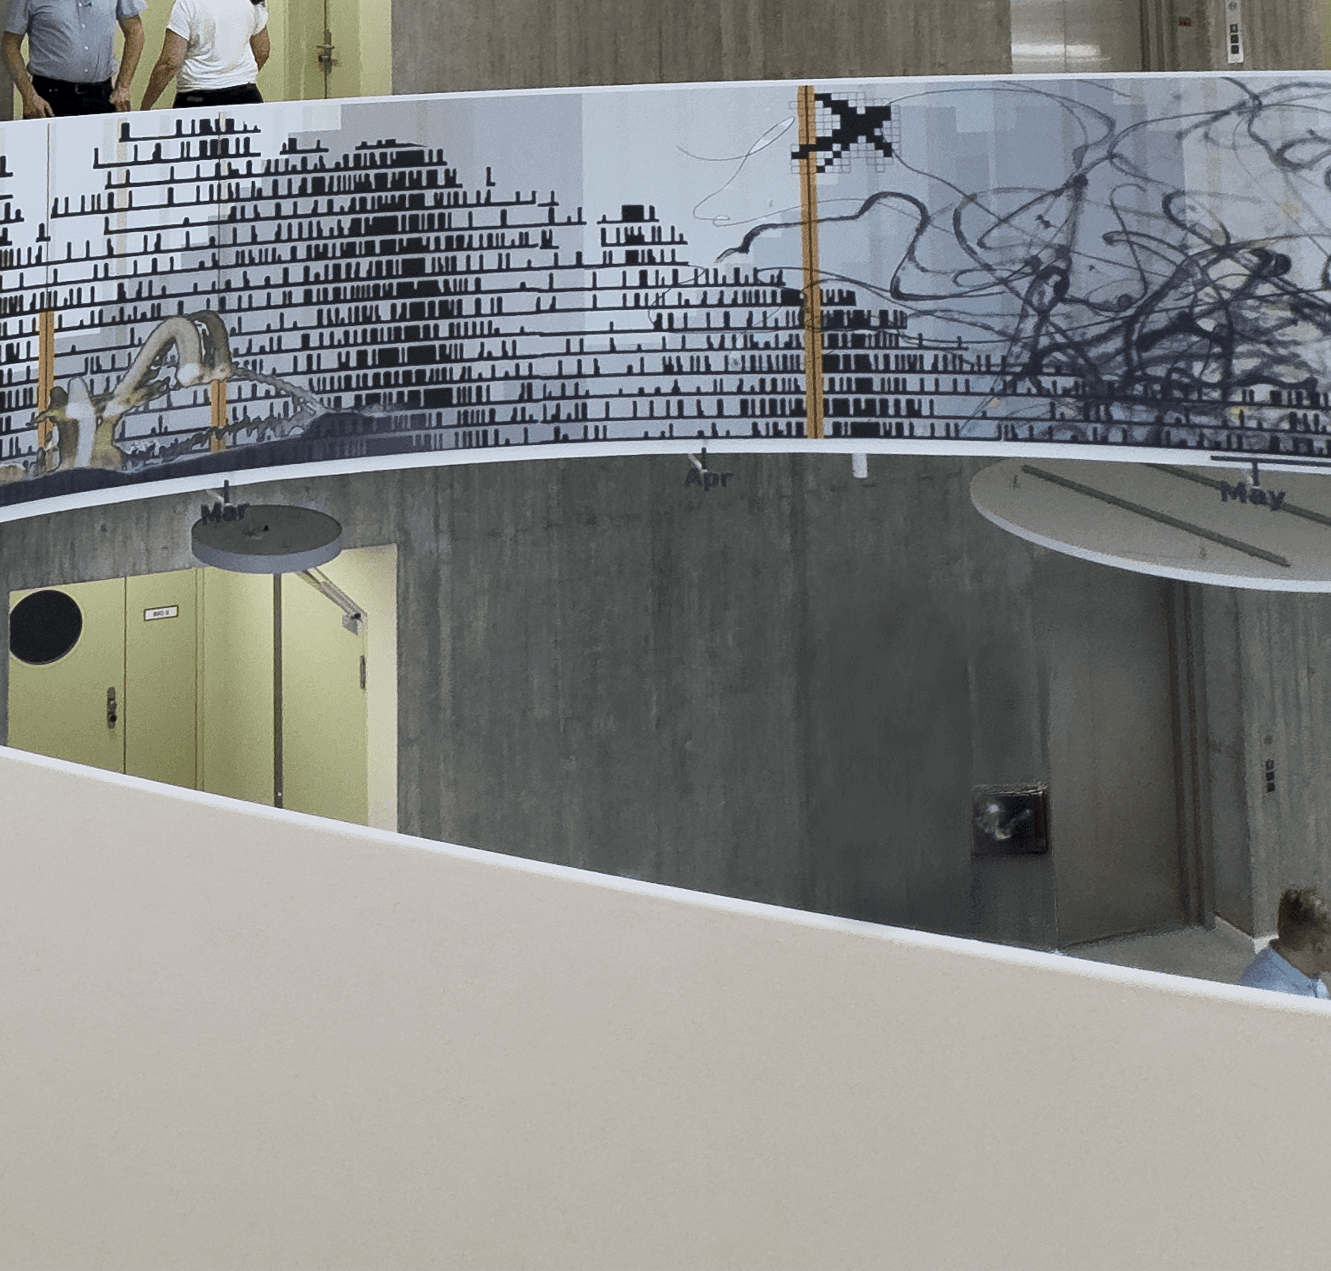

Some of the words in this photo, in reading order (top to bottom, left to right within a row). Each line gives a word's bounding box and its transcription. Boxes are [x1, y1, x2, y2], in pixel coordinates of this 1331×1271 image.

[200, 501, 250, 525] Mar
[685, 466, 733, 492] Apr
[1220, 480, 1286, 511] May
